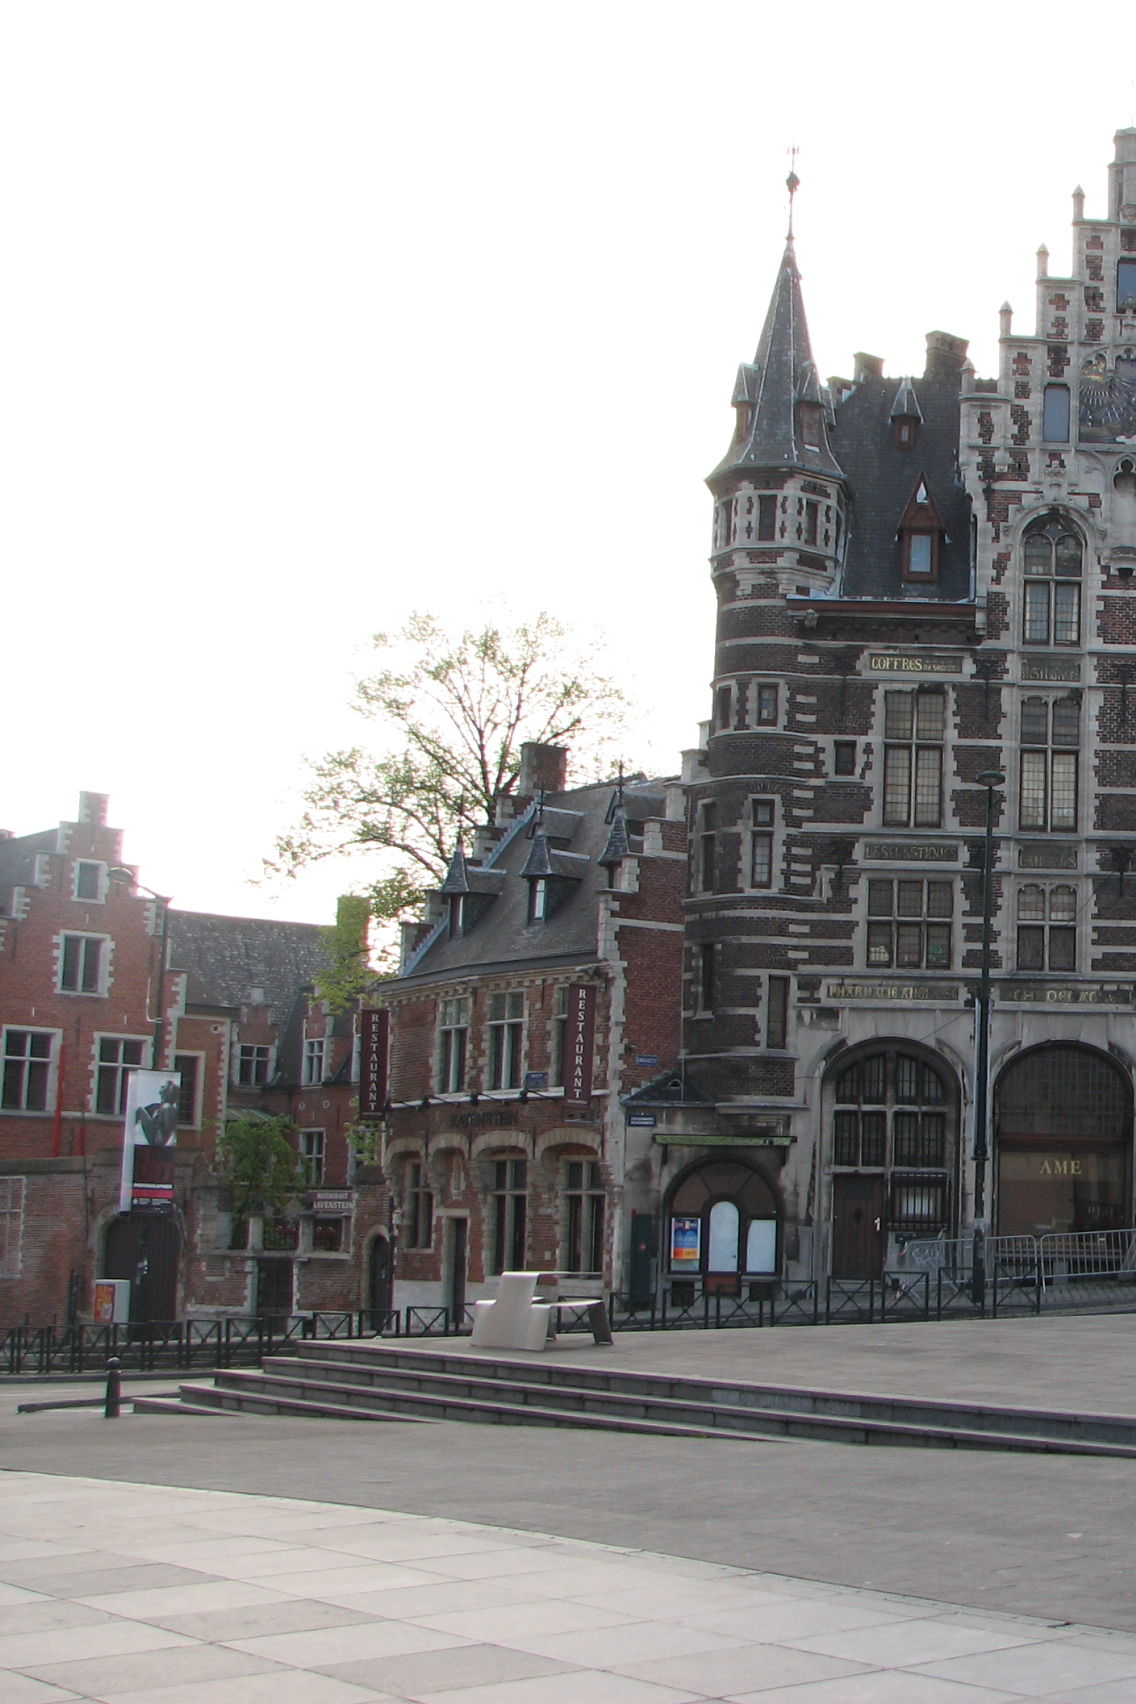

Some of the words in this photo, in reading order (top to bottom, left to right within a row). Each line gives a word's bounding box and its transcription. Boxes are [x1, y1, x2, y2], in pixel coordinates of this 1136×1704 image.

[369, 1013, 380, 1111] RESTAURANT
[572, 988, 587, 1099] RESTAURANT
[1040, 1159, 1082, 1175] AME
